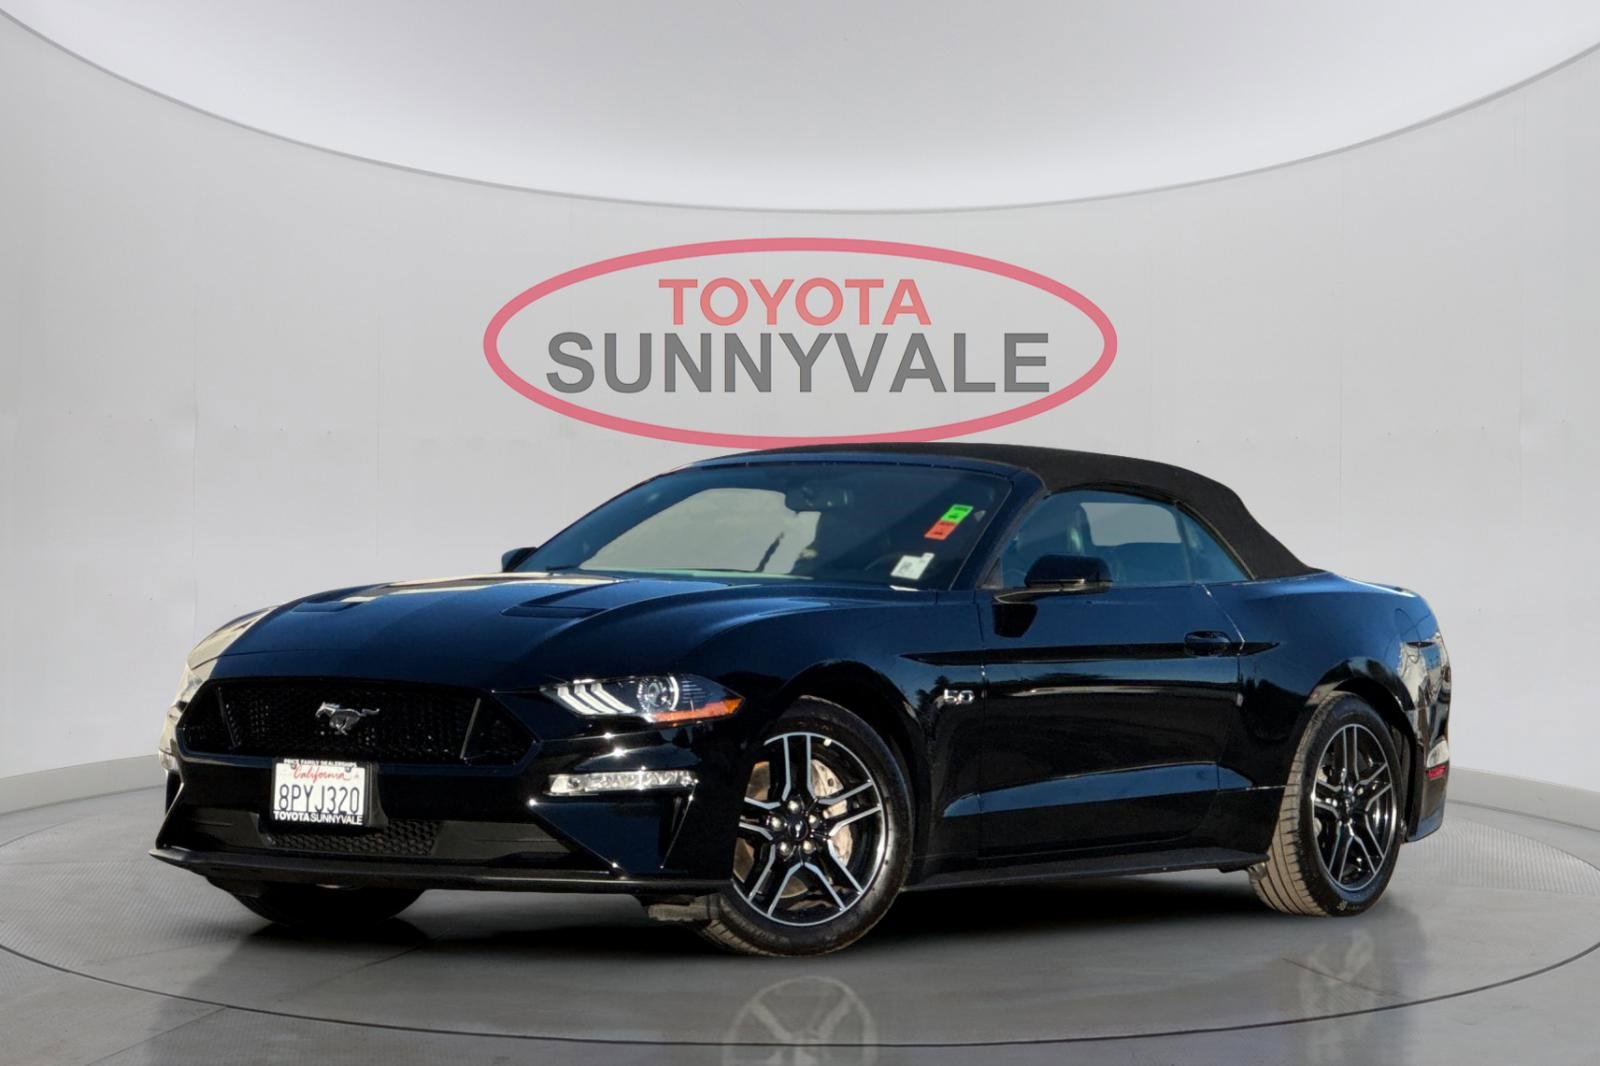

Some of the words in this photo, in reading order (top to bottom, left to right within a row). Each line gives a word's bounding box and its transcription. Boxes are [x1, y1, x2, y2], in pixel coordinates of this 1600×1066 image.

[659, 277, 932, 326] TOYOTA
[546, 332, 1050, 394] SUNNYVALE
[292, 765, 350, 783] California
[278, 784, 360, 814] 8PYJ320
[274, 811, 310, 821] TOYOTA
[310, 813, 363, 825] SUNNYVALE
